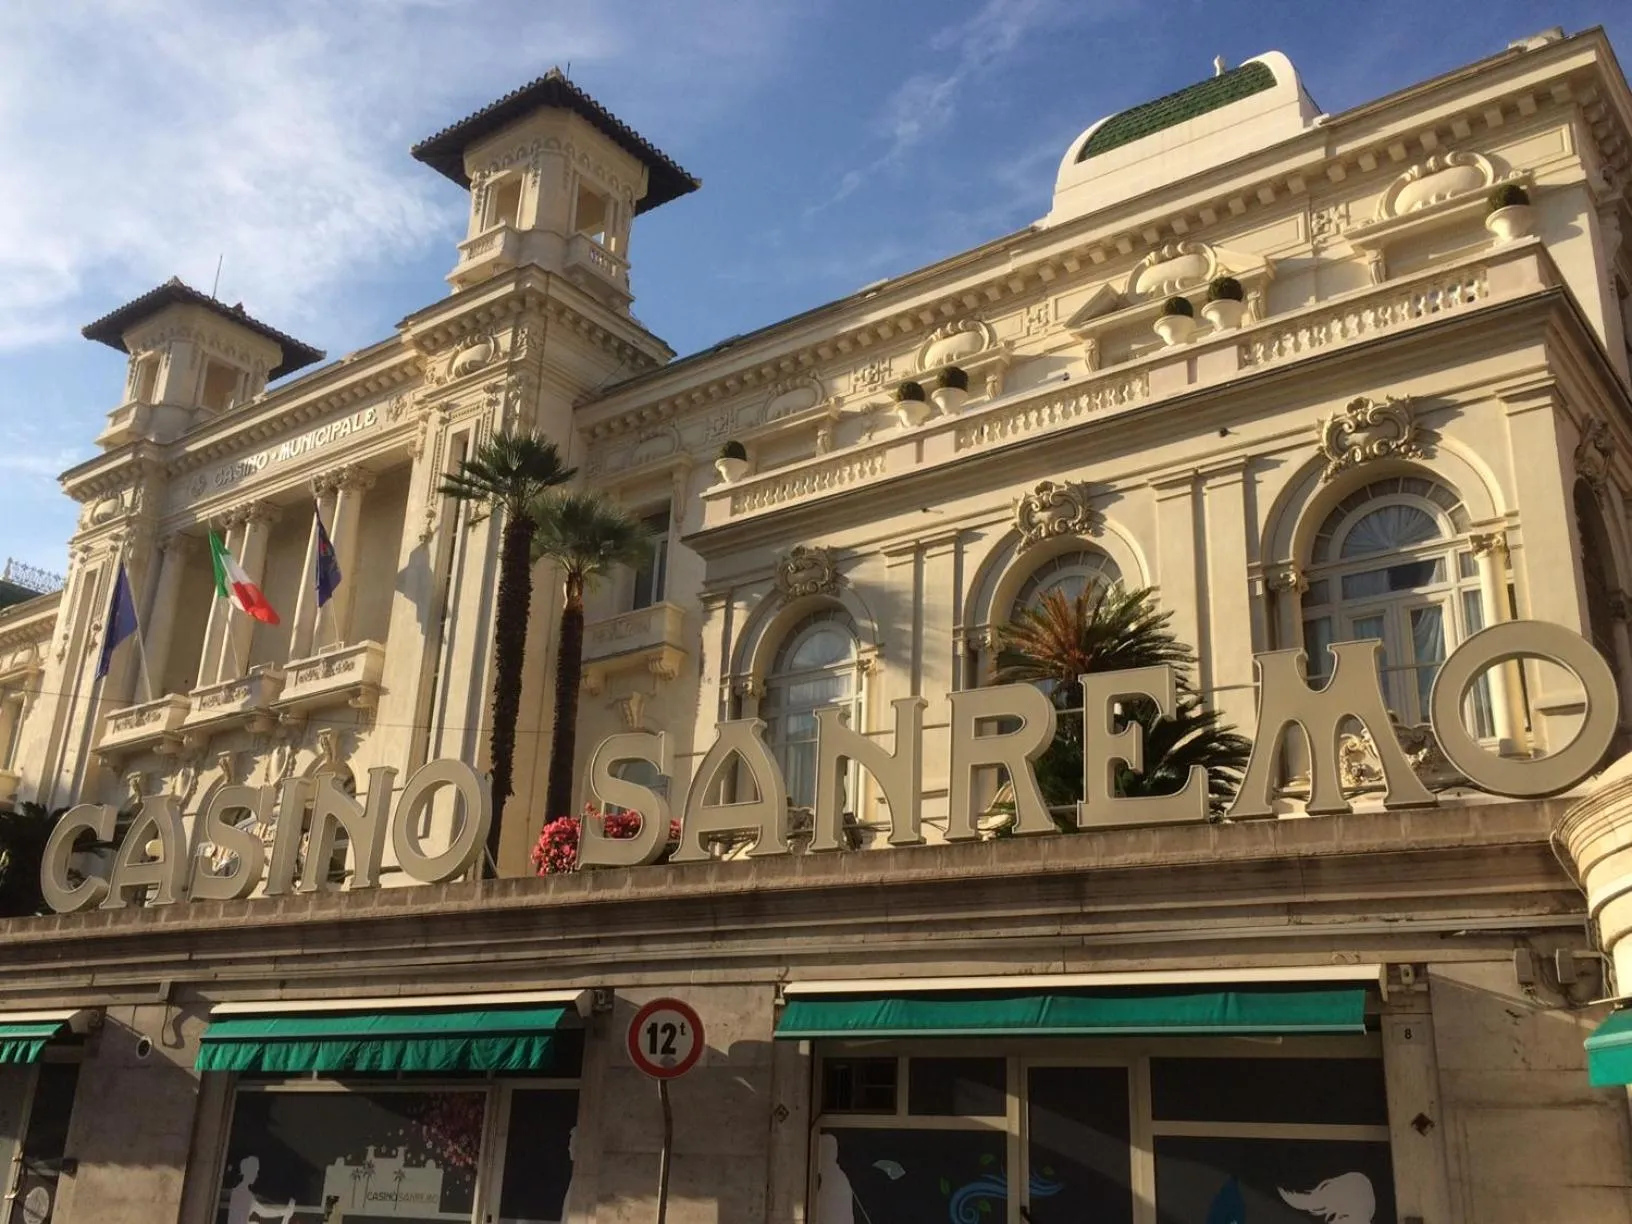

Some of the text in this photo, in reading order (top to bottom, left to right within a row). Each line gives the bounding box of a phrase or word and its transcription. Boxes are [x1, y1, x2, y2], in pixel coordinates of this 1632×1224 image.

[213, 407, 378, 488] CASINO MUNICIPALE
[40, 620, 1619, 914] CASINO SANREMO
[1404, 1028, 1412, 1040] 8
